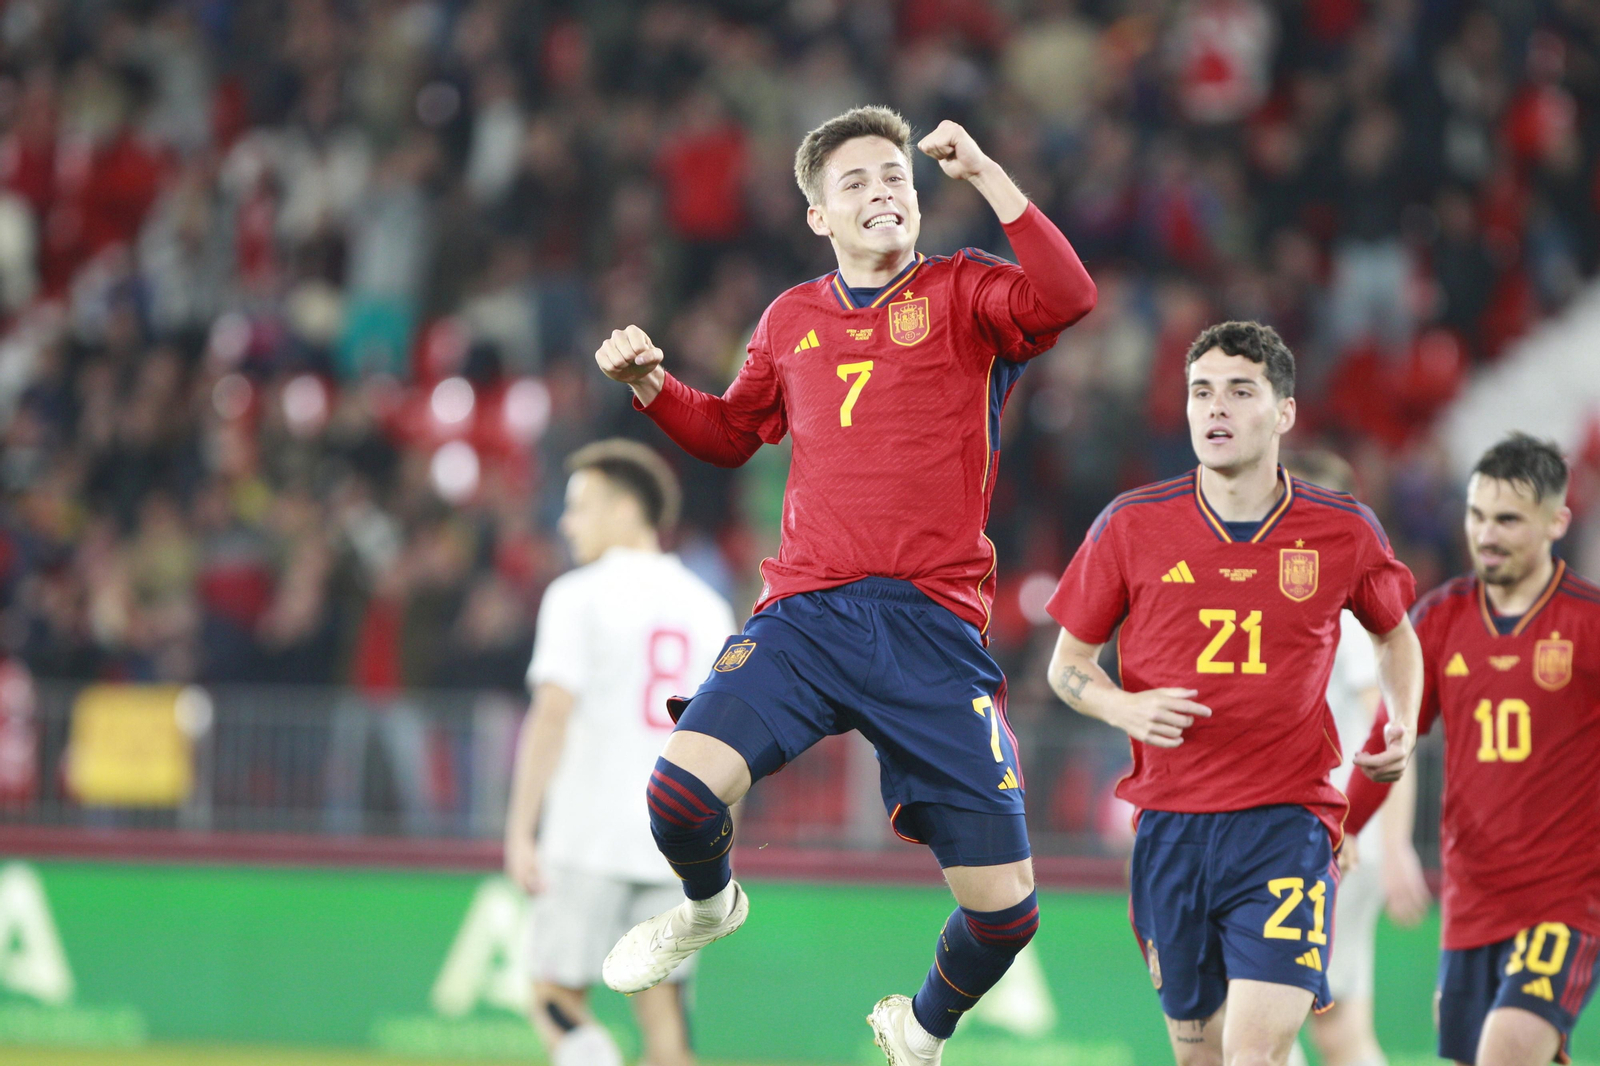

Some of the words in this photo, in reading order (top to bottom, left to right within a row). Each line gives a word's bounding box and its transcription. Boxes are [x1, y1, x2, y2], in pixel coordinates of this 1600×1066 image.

[836, 360, 874, 427] 7
[1196, 608, 1267, 675] 21
[643, 629, 690, 731] 8
[972, 695, 1004, 763] 7
[1474, 697, 1532, 763] 10
[1263, 877, 1327, 946] 21
[1505, 921, 1571, 976] 10
